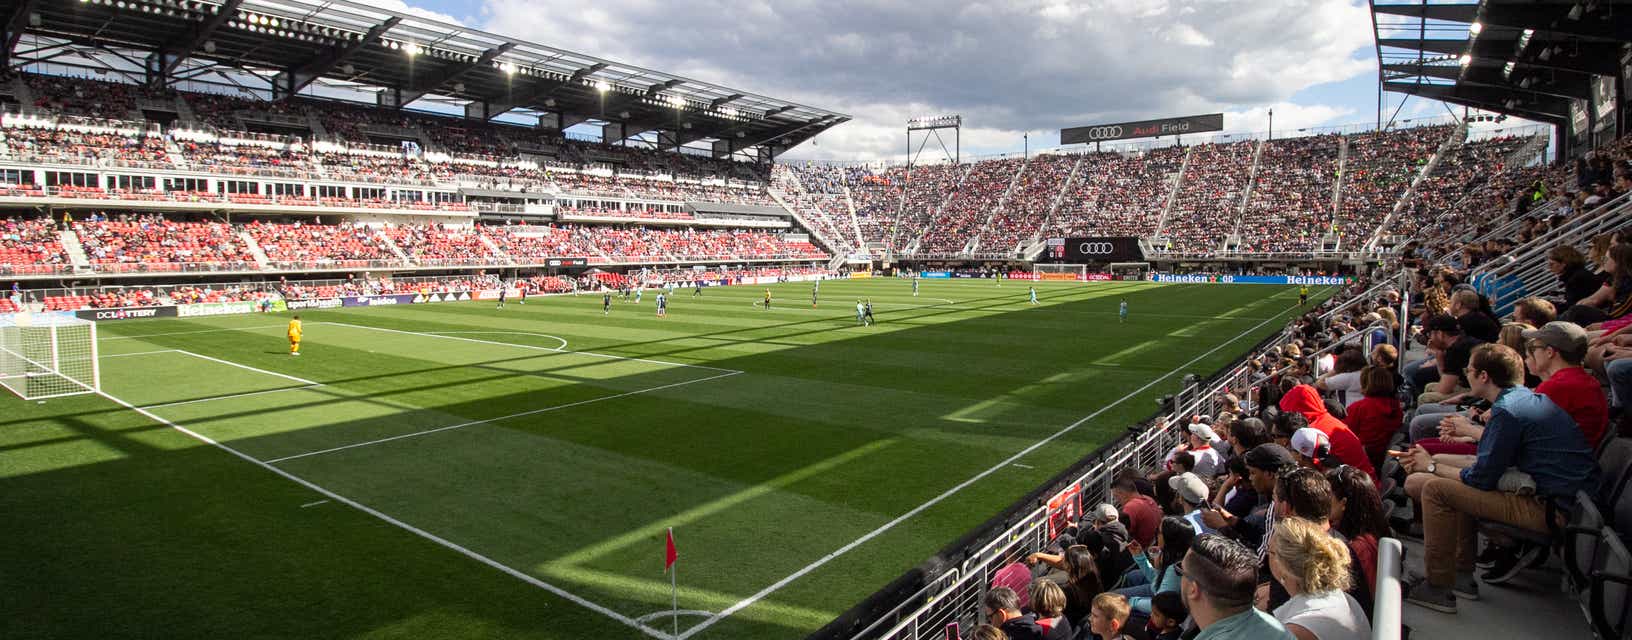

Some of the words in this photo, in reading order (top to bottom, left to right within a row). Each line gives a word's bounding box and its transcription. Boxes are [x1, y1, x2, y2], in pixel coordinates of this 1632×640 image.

[1134, 124, 1159, 135] Audi
[1161, 121, 1189, 132] Field
[1158, 273, 1208, 283] Heineken
[1287, 275, 1345, 285] Heineken
[369, 297, 397, 306] leidos
